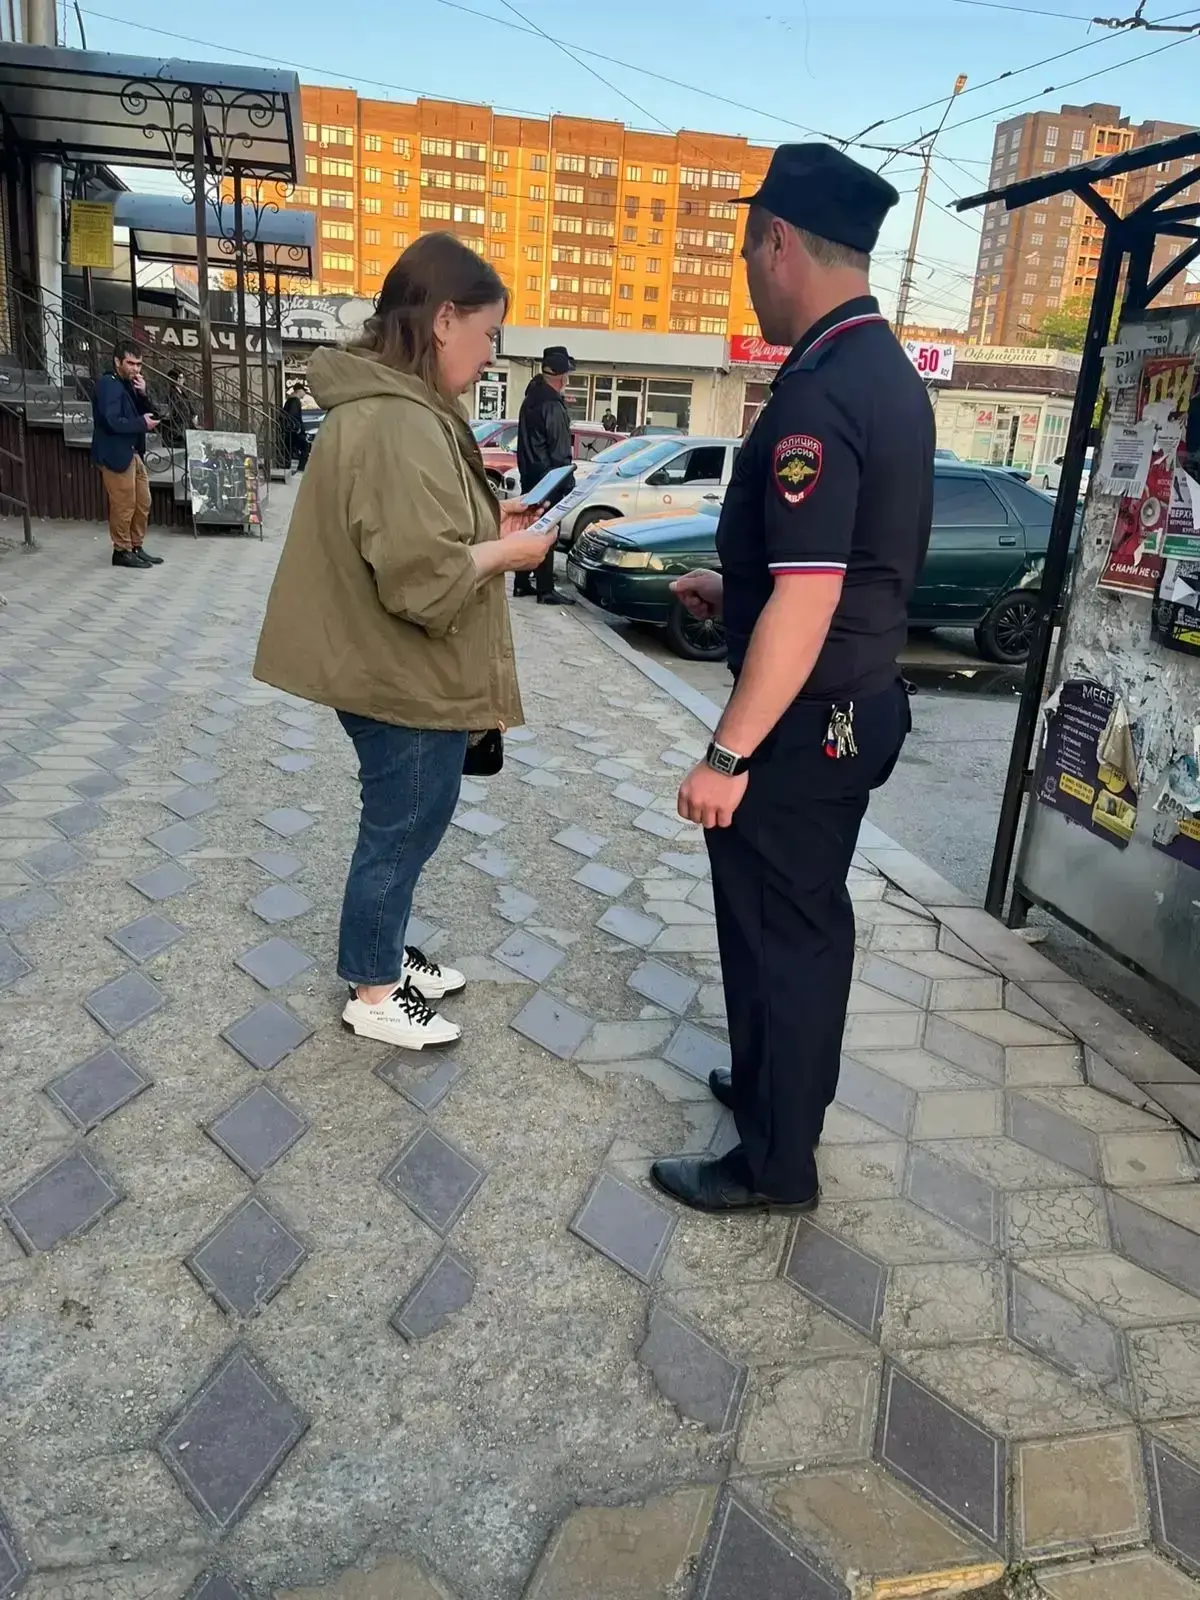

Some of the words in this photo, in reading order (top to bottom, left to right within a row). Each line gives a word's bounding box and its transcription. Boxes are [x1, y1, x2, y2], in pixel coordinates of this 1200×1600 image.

[312, 298, 338, 315] vita
[918, 348, 940, 373] 50
[977, 410, 993, 422] 24
[776, 437, 819, 453] ПОЛИЦИЯ
[780, 447, 815, 461] РОССИЯ
[1110, 563, 1116, 572] С
[1115, 564, 1138, 575] НАМИ
[1139, 569, 1150, 577] НЕ
